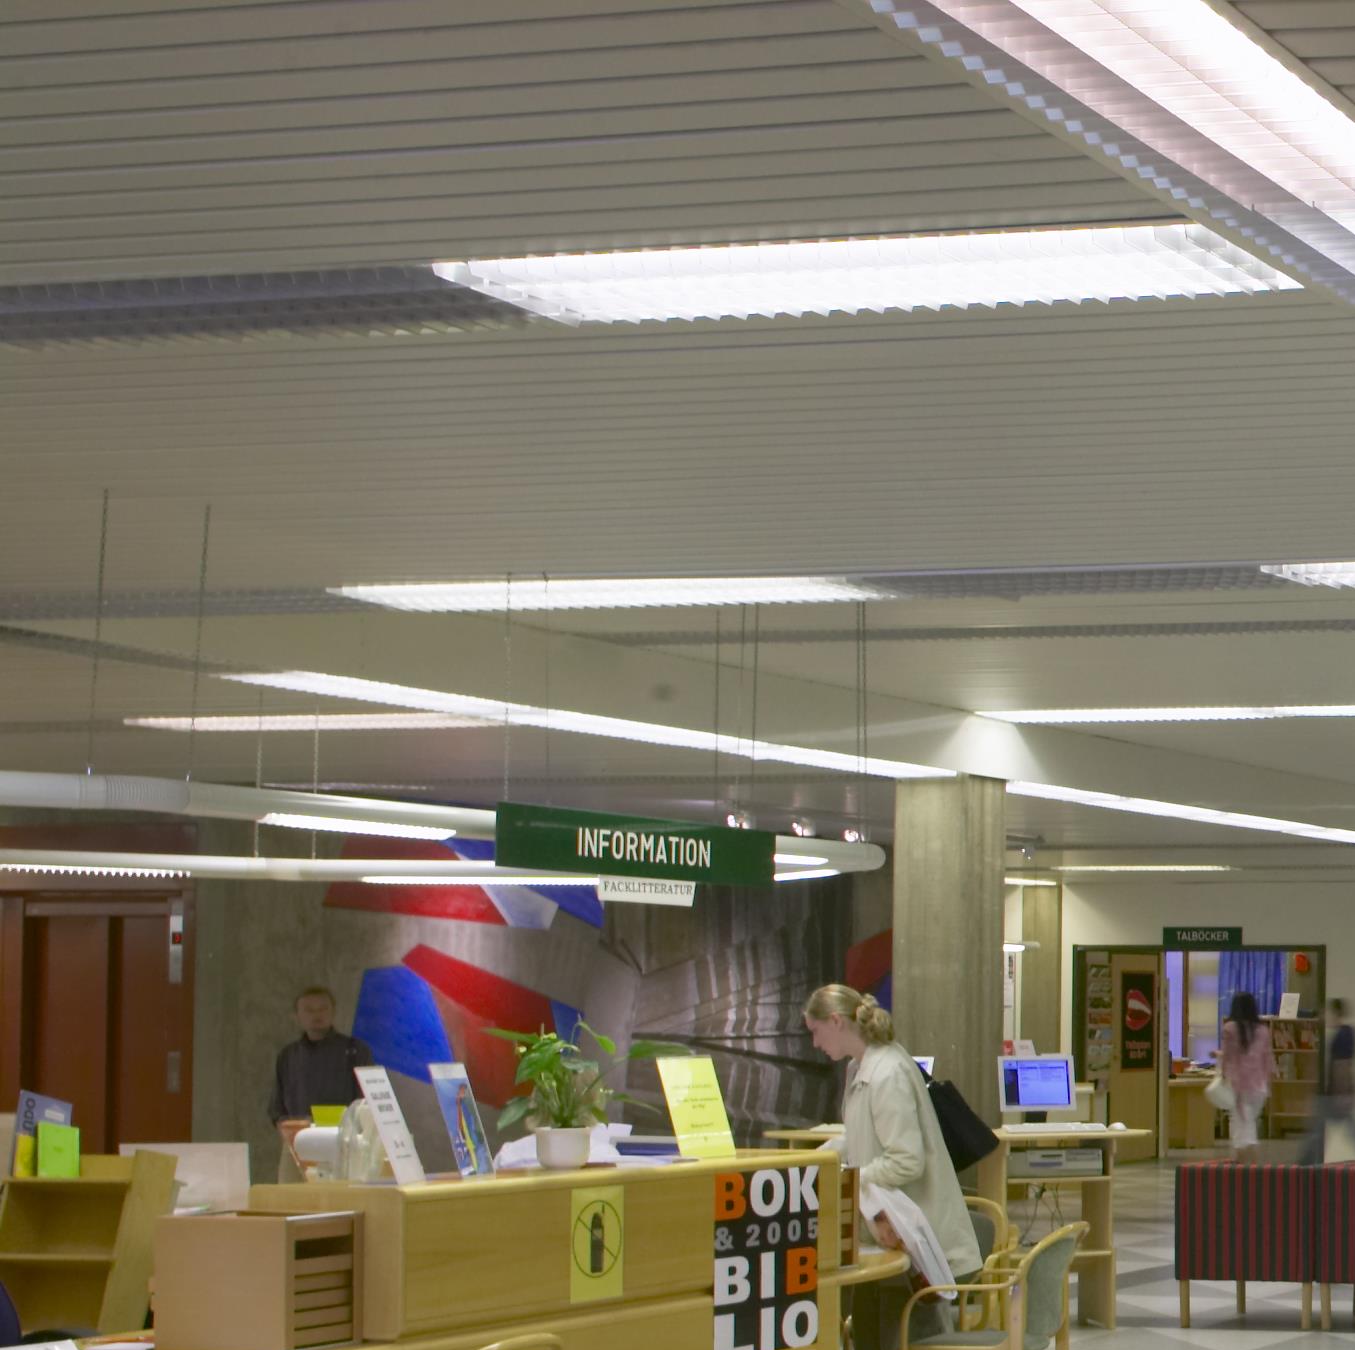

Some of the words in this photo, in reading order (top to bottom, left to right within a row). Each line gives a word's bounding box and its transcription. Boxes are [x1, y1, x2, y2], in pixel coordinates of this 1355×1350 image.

[576, 826, 711, 869] INFORMATION
[603, 879, 693, 896] FACKLITTERATUR
[1176, 929, 1229, 942] TALBÖCKER
[714, 1164, 820, 1222] BOK
[714, 1226, 734, 1251] &
[745, 1218, 819, 1247] 2005
[714, 1246, 818, 1307] BIB
